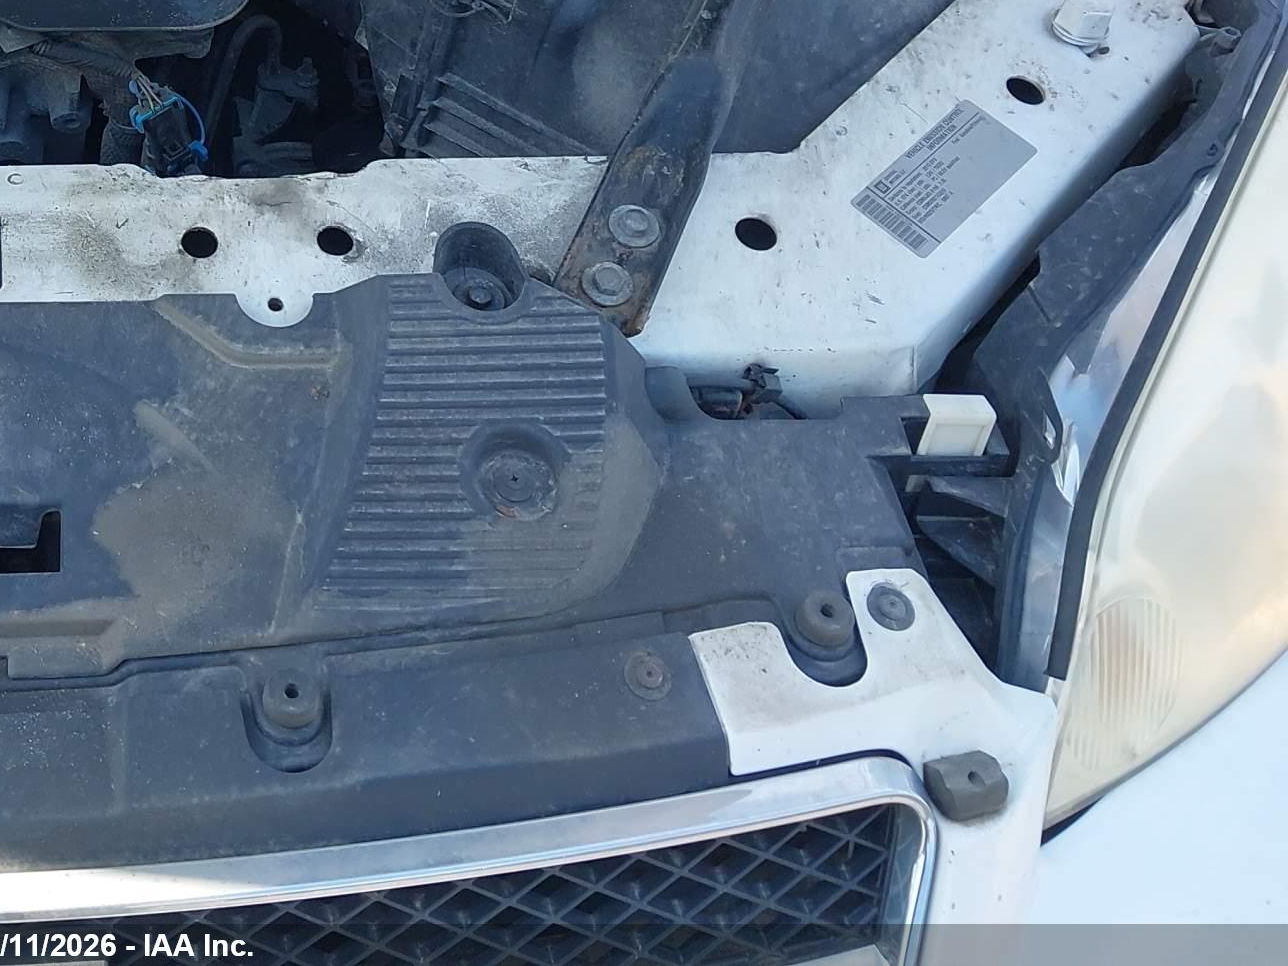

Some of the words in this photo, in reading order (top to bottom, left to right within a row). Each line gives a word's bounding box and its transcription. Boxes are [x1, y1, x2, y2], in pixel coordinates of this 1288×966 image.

[904, 141, 925, 159] VEHICLE
[921, 123, 946, 144] EMISSION
[941, 106, 964, 126] CONTROL
[925, 123, 957, 151] INFORMATION
